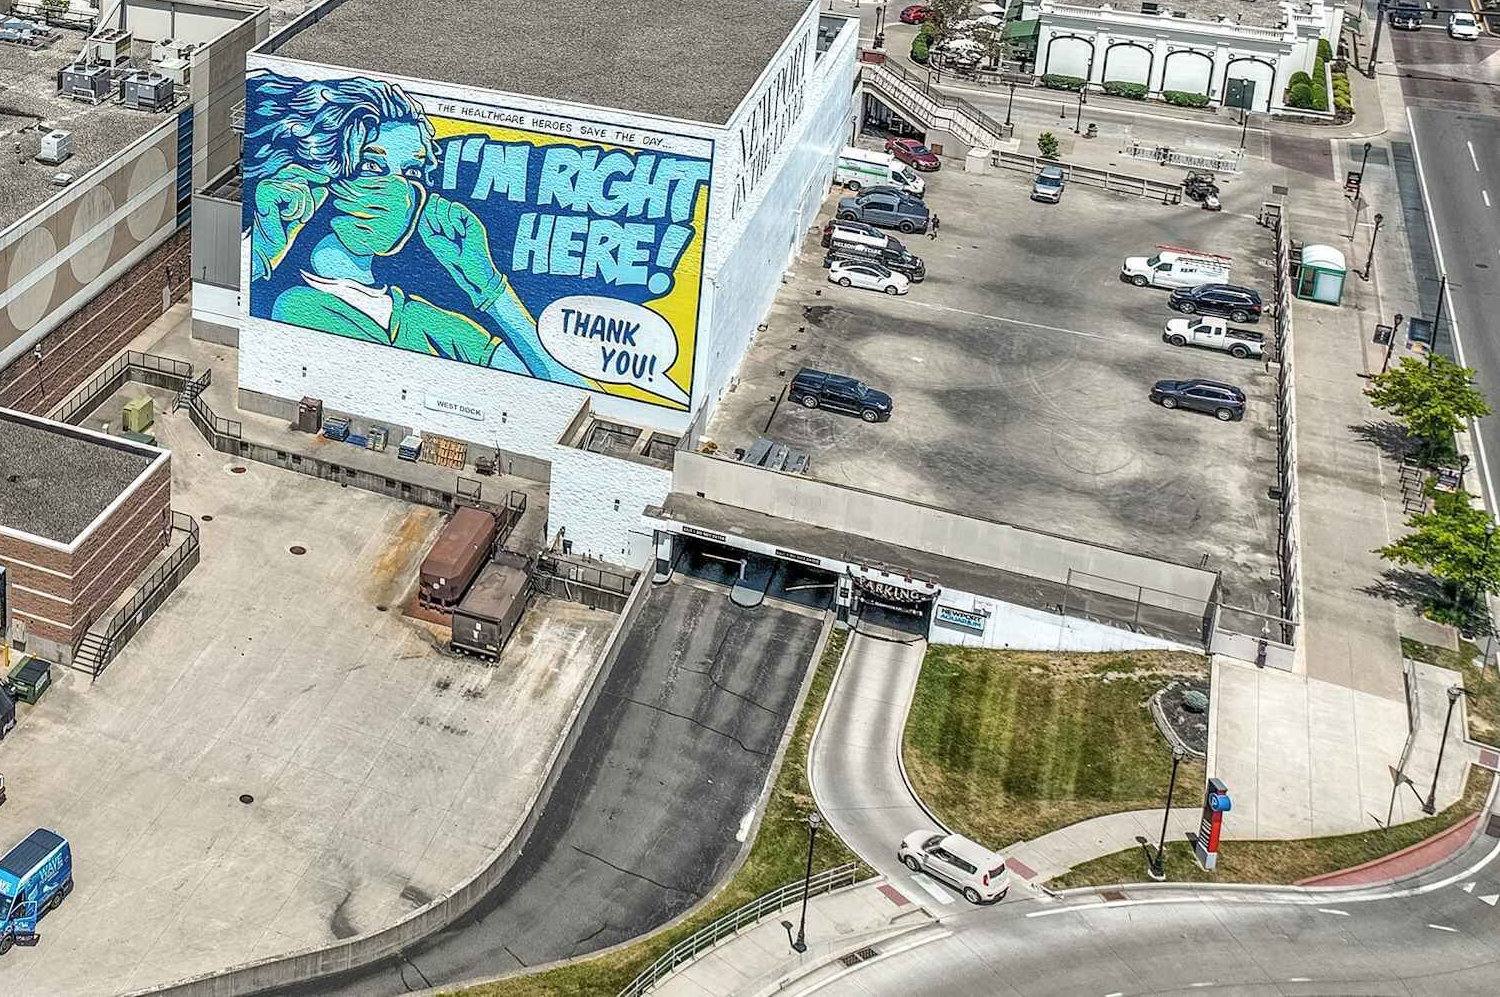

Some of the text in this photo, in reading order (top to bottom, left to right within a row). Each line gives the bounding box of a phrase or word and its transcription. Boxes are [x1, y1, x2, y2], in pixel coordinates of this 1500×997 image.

[740, 28, 811, 167] NEWPORT
[437, 103, 456, 114] THE
[461, 106, 525, 126] HEALTHCARE
[531, 117, 573, 133] HEROES
[580, 125, 607, 138] SAVE
[615, 131, 636, 143] THE
[442, 138, 711, 223] I'M RIGHT
[512, 213, 693, 294] HERE!
[561, 308, 640, 347] THANK
[601, 345, 657, 382] YOU!
[437, 400, 482, 416] WEST DOCK
[859, 575, 920, 599] PARKING
[941, 607, 982, 622] NEWPORT
